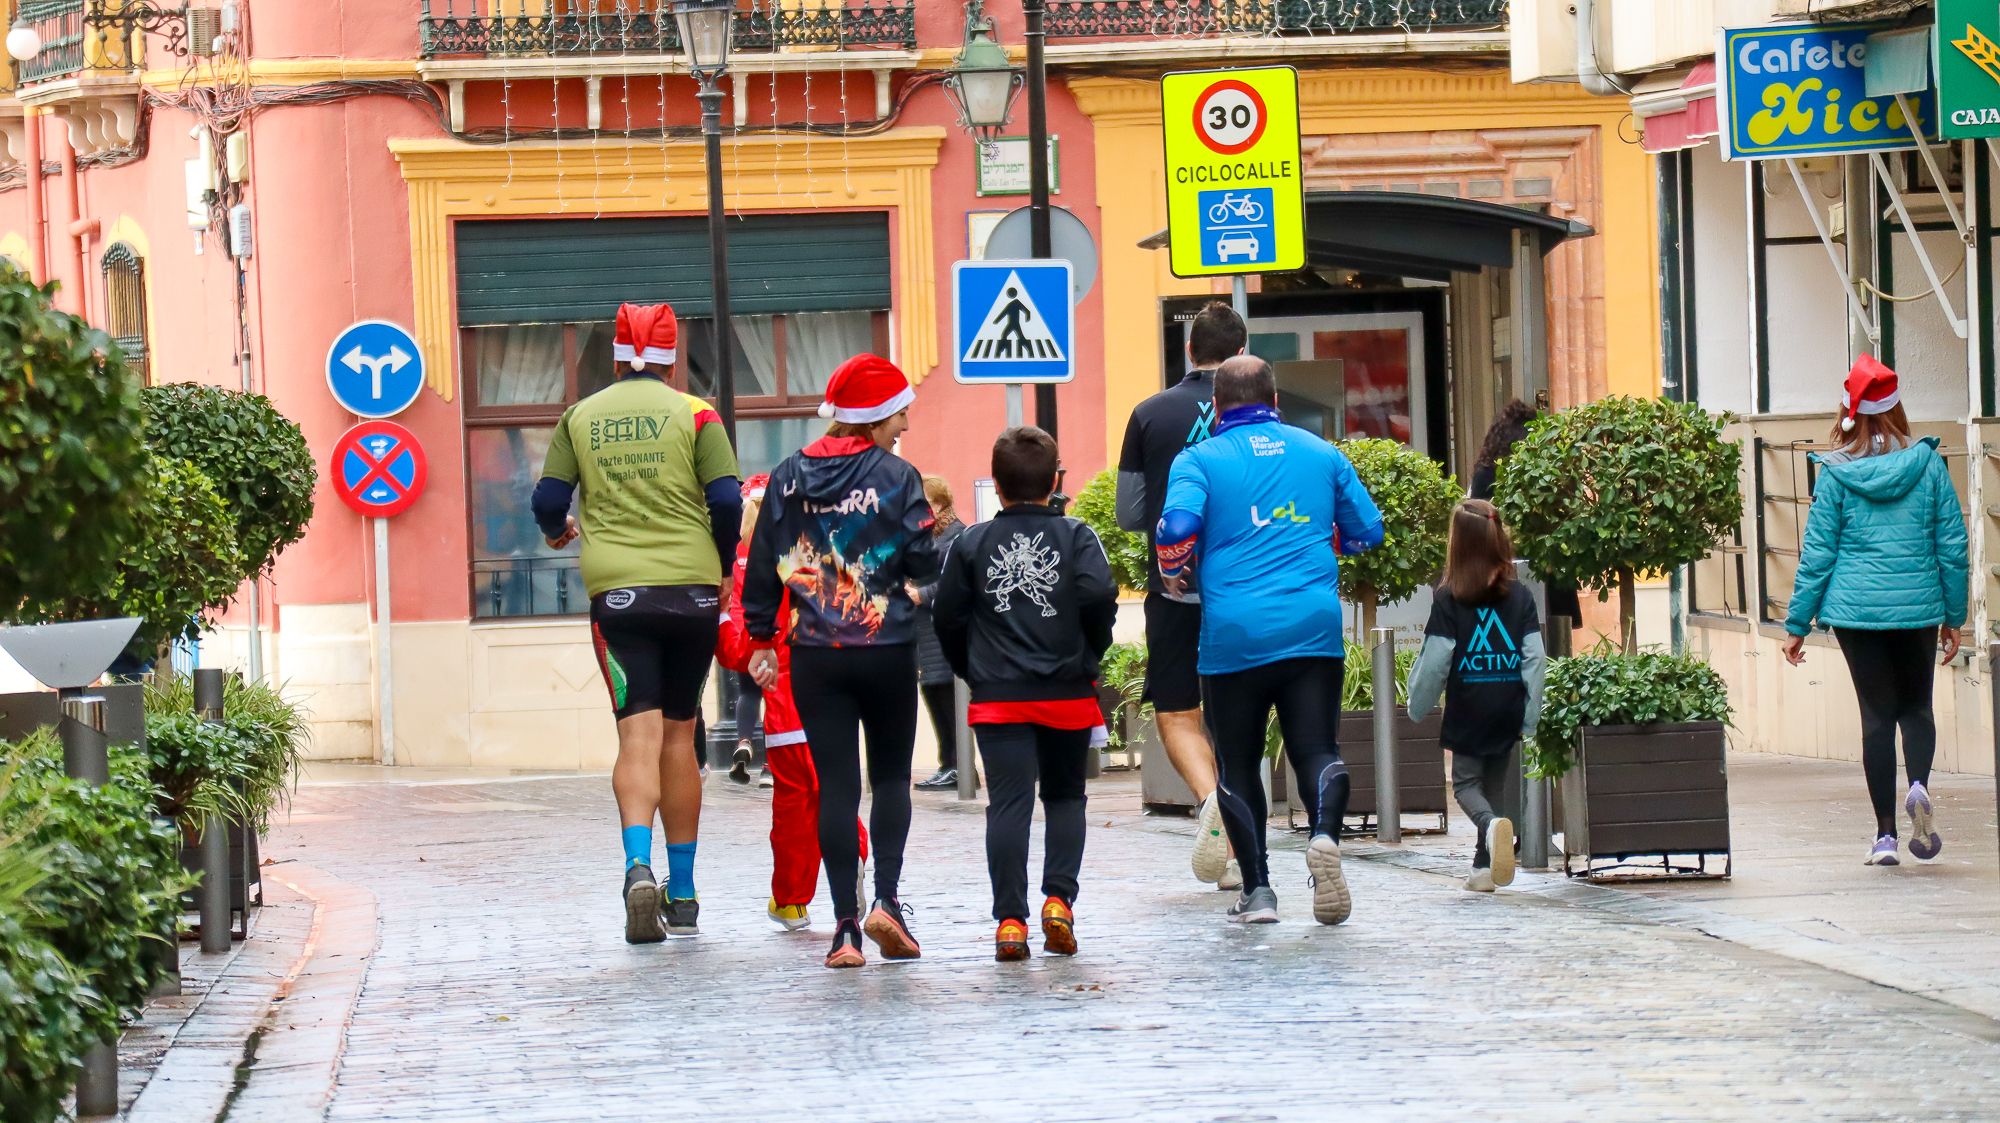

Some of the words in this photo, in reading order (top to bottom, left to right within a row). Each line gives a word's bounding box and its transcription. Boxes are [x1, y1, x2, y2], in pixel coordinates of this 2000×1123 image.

[1739, 37, 1866, 74] Cafete
[1209, 104, 1251, 130] 30
[1176, 160, 1291, 184] CICLOCALLE
[590, 420, 600, 451] 2023
[1249, 435, 1270, 443] Club
[1252, 440, 1286, 449] Maratón
[1253, 447, 1285, 457] Lucena
[597, 455, 622, 468] Hazte
[624, 451, 666, 465] DONANTE
[606, 469, 637, 483] Regala
[637, 467, 659, 479] VIDA
